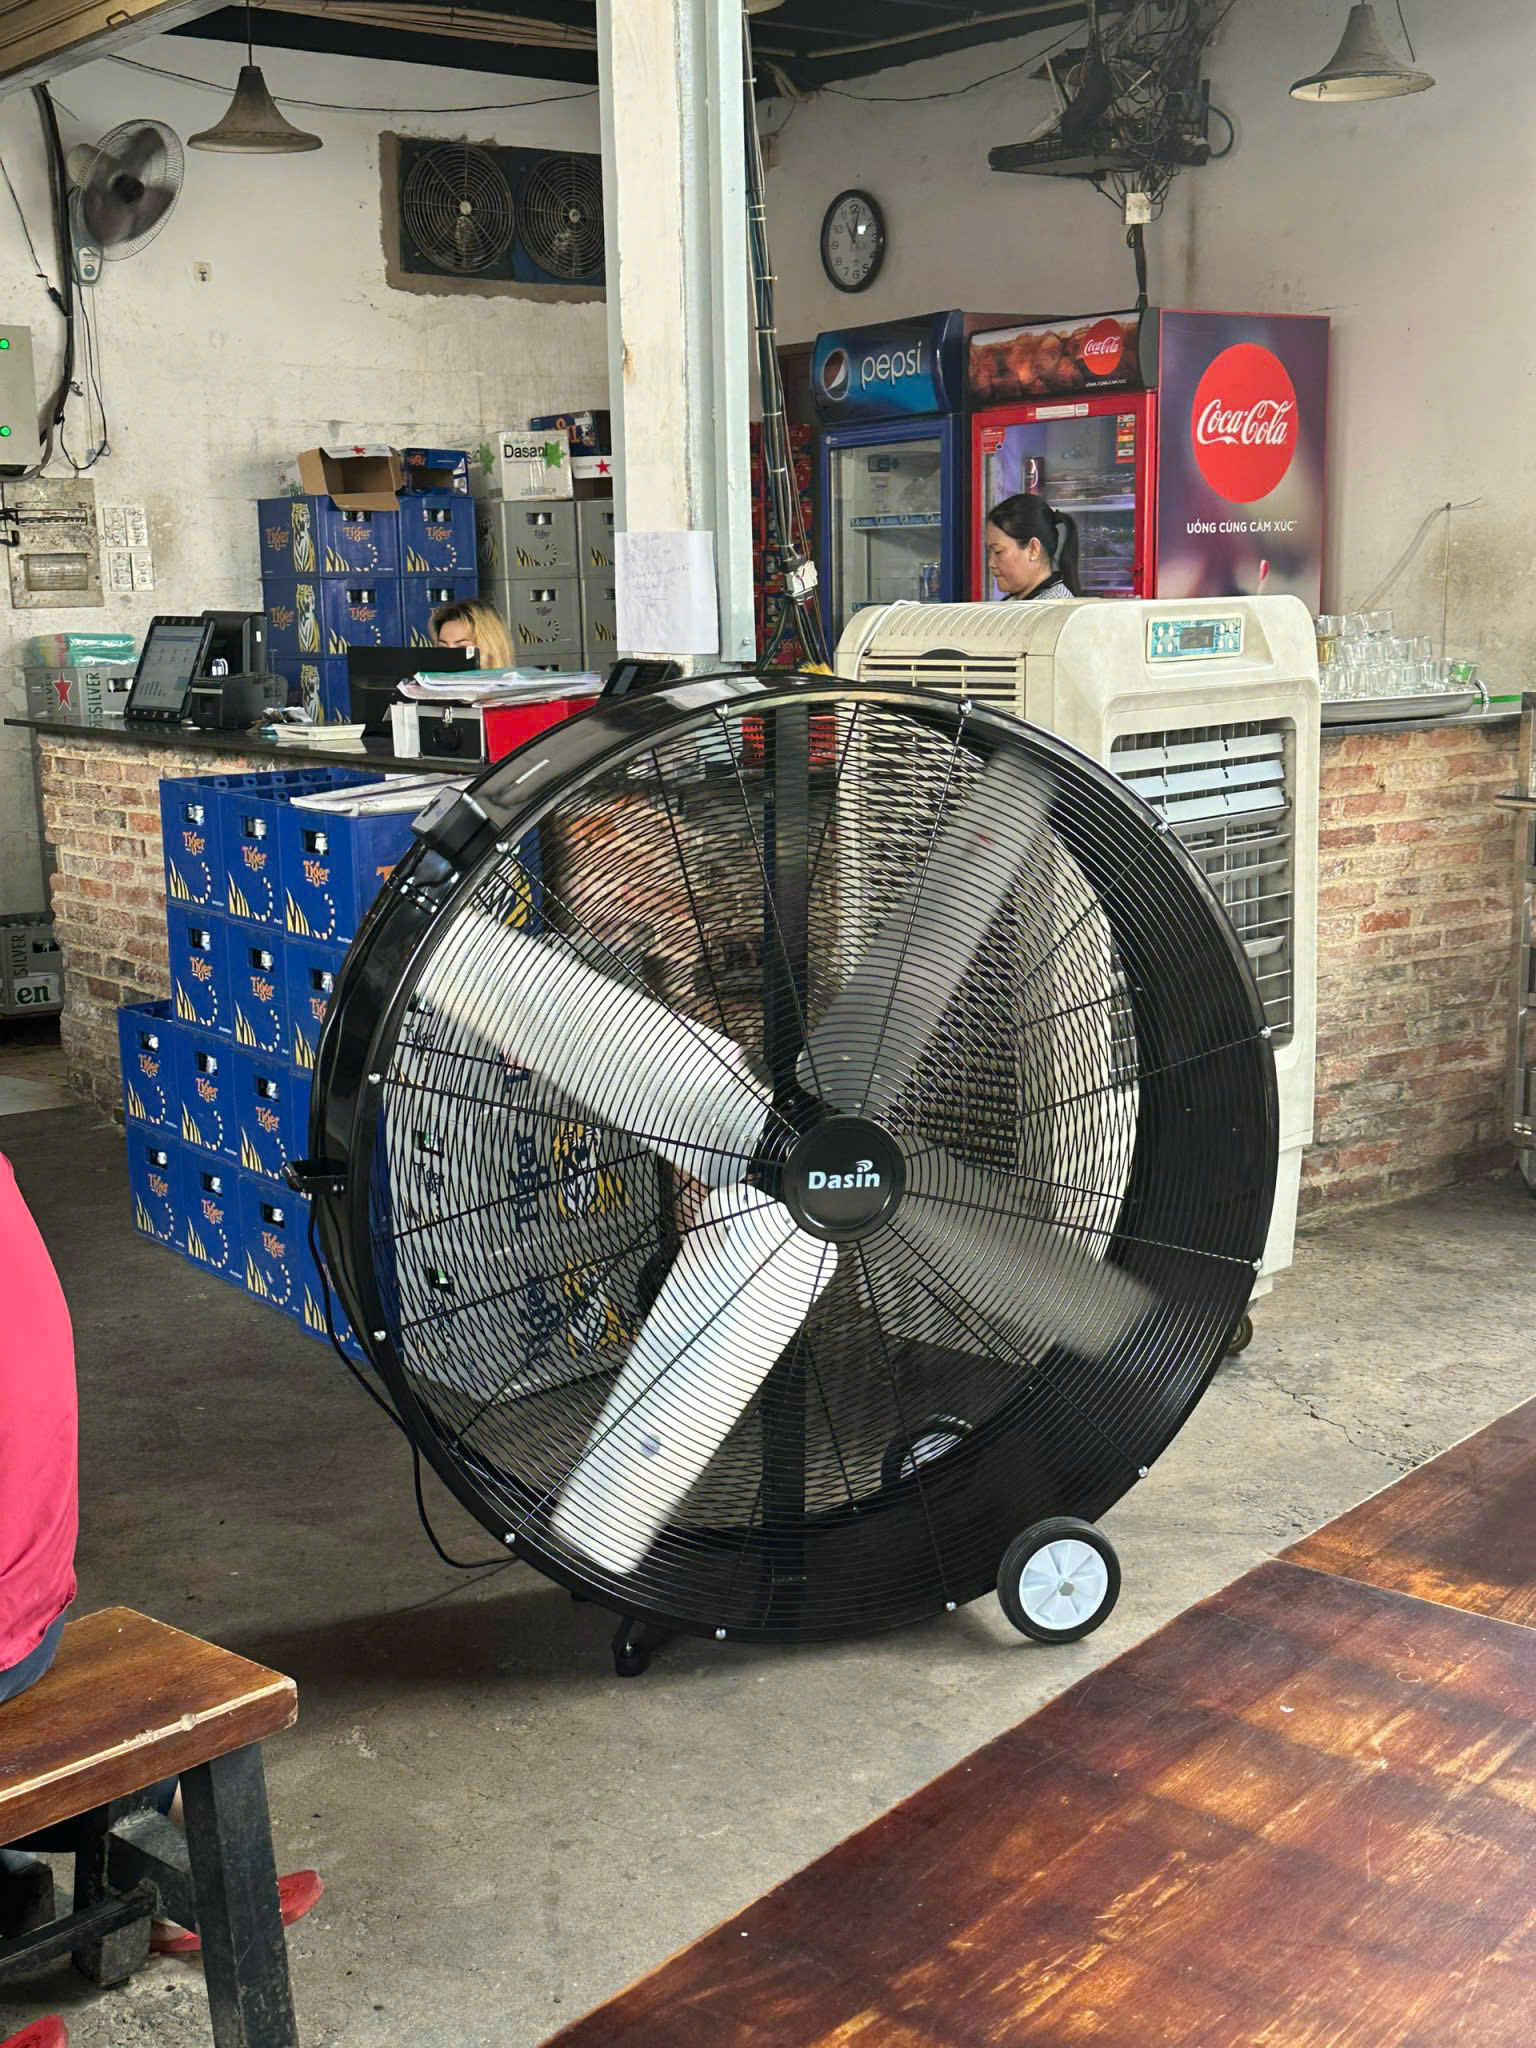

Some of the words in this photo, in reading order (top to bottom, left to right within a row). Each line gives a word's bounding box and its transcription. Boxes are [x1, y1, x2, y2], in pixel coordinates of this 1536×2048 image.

[832, 241, 839, 250] 9
[843, 267, 850, 277] 7
[852, 270, 860, 280] 6
[862, 263, 870, 274] 5
[1083, 335, 1121, 357] Coca-Cola
[861, 341, 922, 391] pepsi
[1196, 399, 1294, 445] Coca-Cola
[503, 444, 546, 459] Dasan
[265, 525, 290, 550] Tiger
[343, 526, 373, 541] Tiger
[425, 526, 453, 541] Tiger
[270, 605, 295, 630] Tiger
[349, 605, 377, 622] Tiger
[86, 672, 103, 714] SILVER
[183, 831, 206, 856] Tiger
[241, 845, 268, 872] Tiger
[302, 860, 330, 888] Tiger
[11, 935, 29, 977] SILVER
[189, 955, 213, 982] Tiger
[250, 975, 275, 1002] Tiger
[309, 997, 327, 1024] Tig
[138, 1053, 160, 1078] Tiger
[195, 1077, 219, 1103] Tiger
[256, 1105, 280, 1133] Tiger
[148, 1173, 169, 1198] Tiger
[509, 1130, 548, 1233] Tiger
[808, 1162, 880, 1189] Dasin
[201, 1199, 224, 1225] Tiger
[262, 1231, 286, 1258] Tiger
